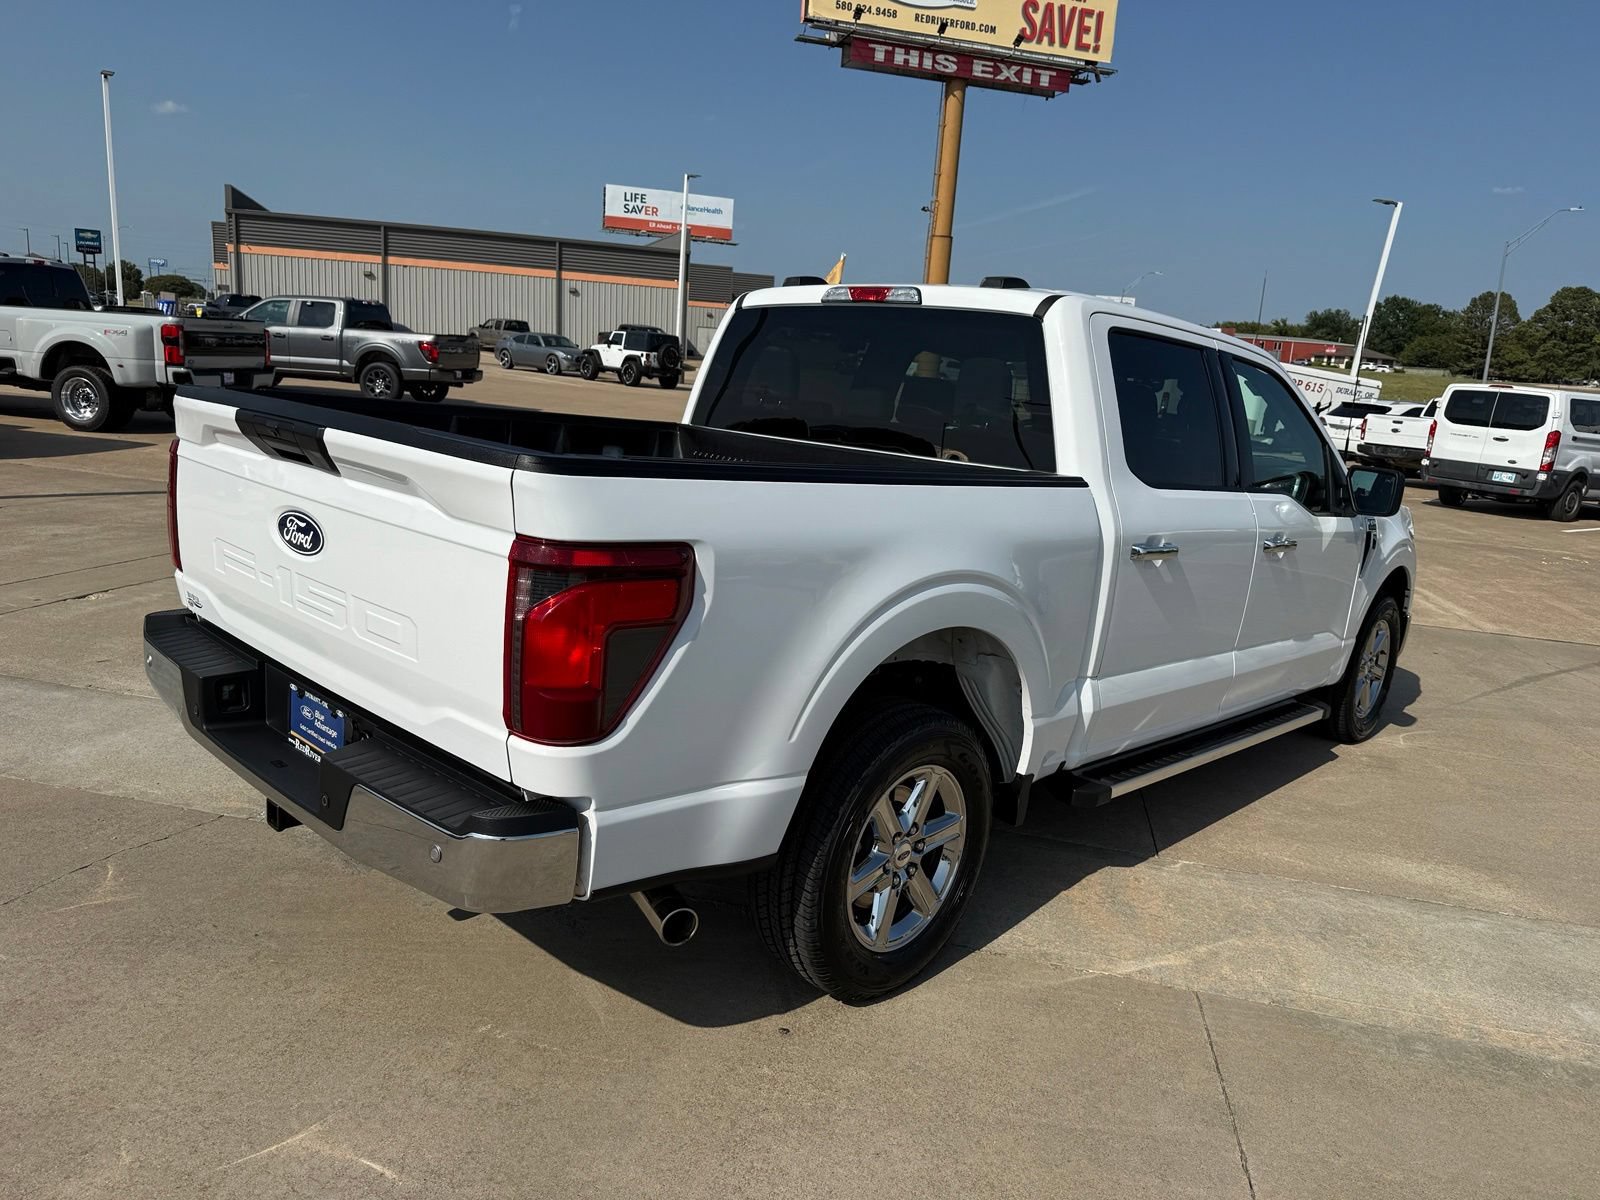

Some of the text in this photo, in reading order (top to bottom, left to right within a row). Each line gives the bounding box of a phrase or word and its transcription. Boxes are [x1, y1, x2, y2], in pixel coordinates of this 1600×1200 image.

[914, 13, 997, 35] REDRIVERFORD.COM
[1019, 0, 1104, 53] SAVE!
[868, 43, 1057, 87] THIS EXIT
[623, 191, 647, 204] LIFE
[623, 203, 659, 217] SAVER
[1304, 381, 1325, 393] 615
[283, 516, 314, 550] Ford
[213, 537, 419, 664] F-150
